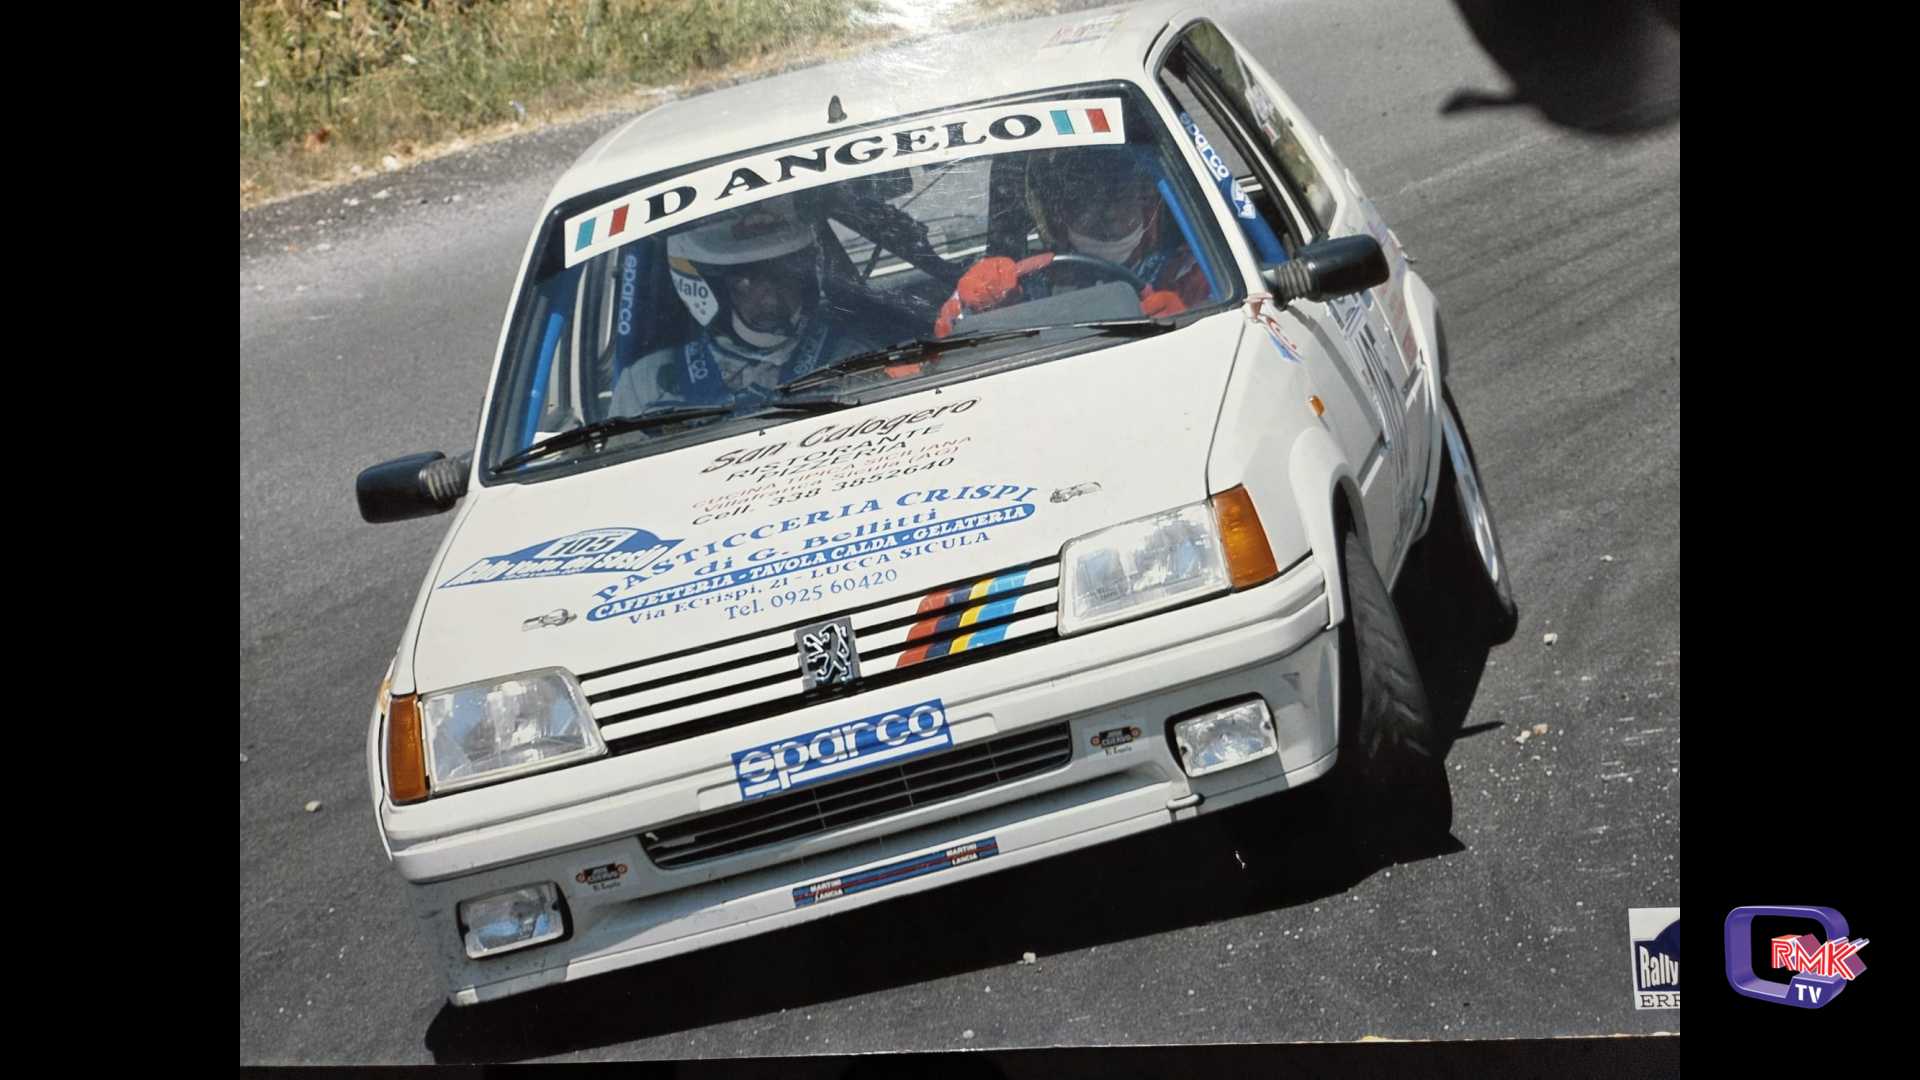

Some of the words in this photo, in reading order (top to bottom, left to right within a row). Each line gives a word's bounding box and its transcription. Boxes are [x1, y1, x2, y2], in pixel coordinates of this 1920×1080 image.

[644, 185, 697, 224] D
[716, 114, 1042, 200] ANGELO
[1180, 112, 1230, 181] sparco
[617, 254, 638, 336] sparco
[700, 441, 789, 473] San
[799, 398, 979, 448] Calogero
[726, 424, 944, 481] RISTORANTE
[756, 442, 906, 482] PIZZERIA
[768, 488, 821, 507] 338
[832, 457, 955, 492] 3852640
[553, 535, 622, 556] 105
[592, 498, 882, 603] PASTICCERIA
[896, 484, 1038, 507] CRISPI
[594, 573, 735, 619] CAFFETTERIA
[750, 551, 830, 580] TAVOLA
[831, 534, 899, 560] CALDA
[913, 506, 1028, 541] GELATERIA
[694, 556, 734, 577] di
[802, 508, 938, 549] Bellitti
[629, 606, 667, 625] Via
[811, 553, 892, 578] LUCCA
[899, 531, 991, 559] SICULA
[724, 599, 765, 621] Tel.
[771, 582, 824, 609] 0925
[830, 568, 898, 595] 60420
[738, 702, 946, 792] sparco
[1639, 944, 1679, 989] Rally
